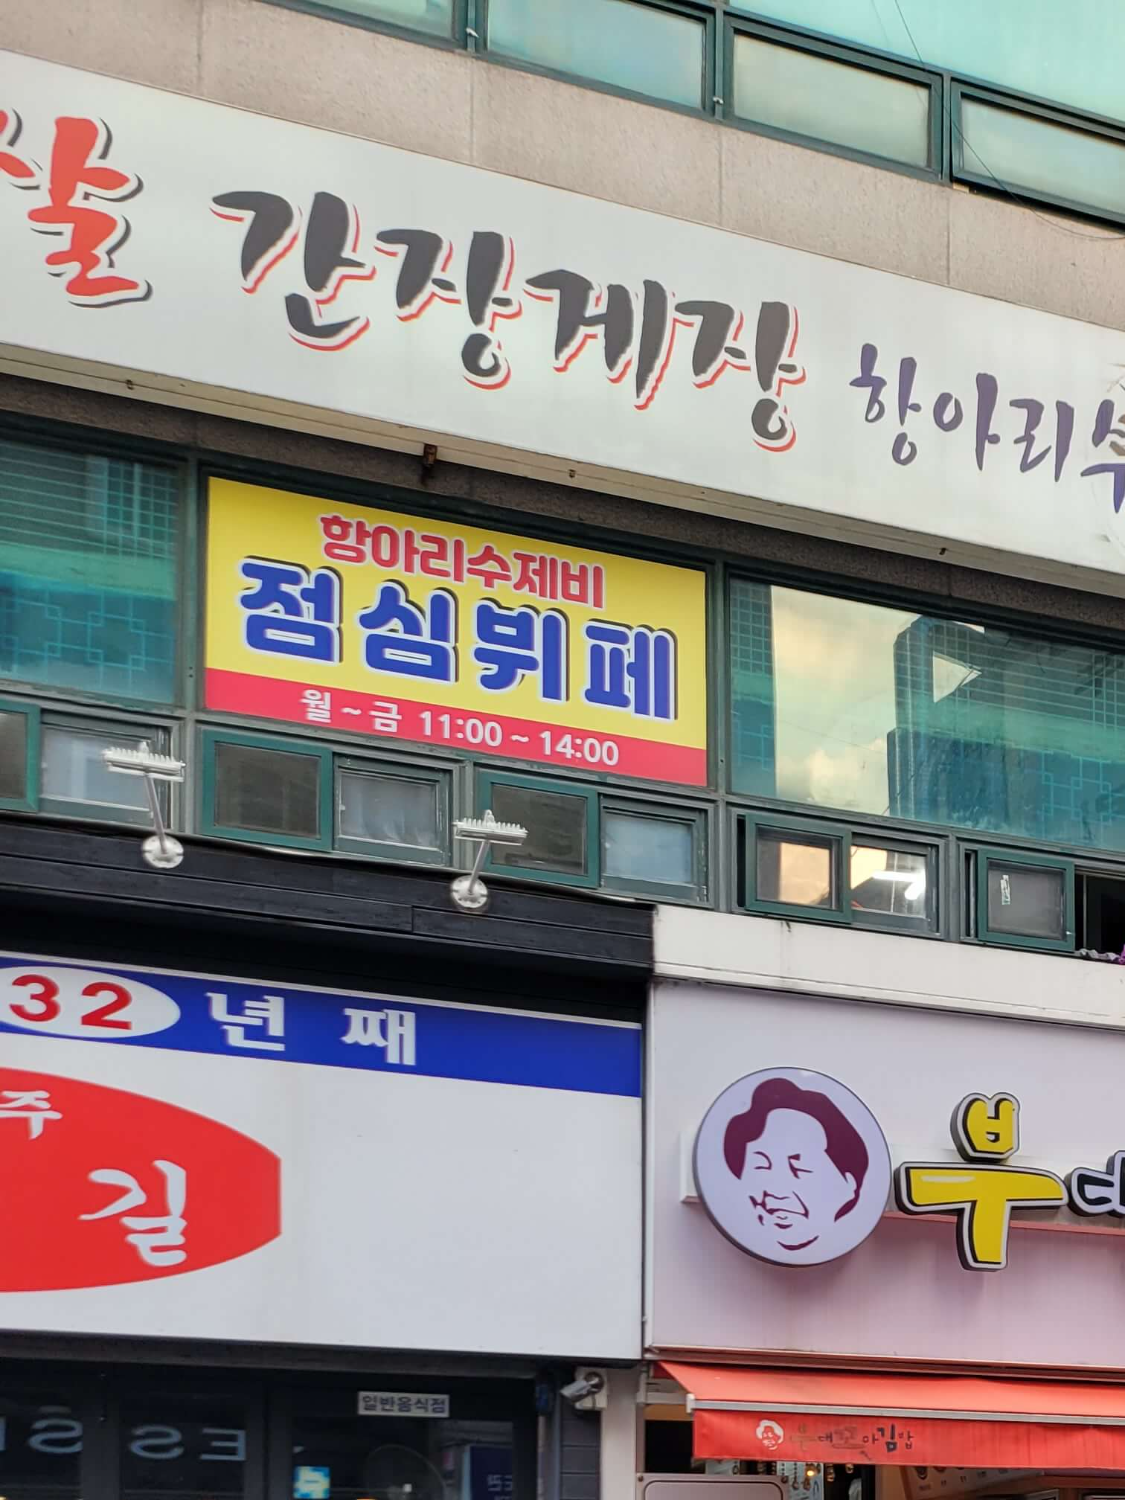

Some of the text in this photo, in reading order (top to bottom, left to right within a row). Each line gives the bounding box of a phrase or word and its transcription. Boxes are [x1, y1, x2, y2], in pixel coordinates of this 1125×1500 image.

[211, 190, 808, 453] 간장게장
[319, 512, 606, 611] 항아리수제비
[239, 557, 679, 722] 점심뷔페
[10, 973, 134, 1031] 32
[362, 1395, 447, 1414] 일반음식점
